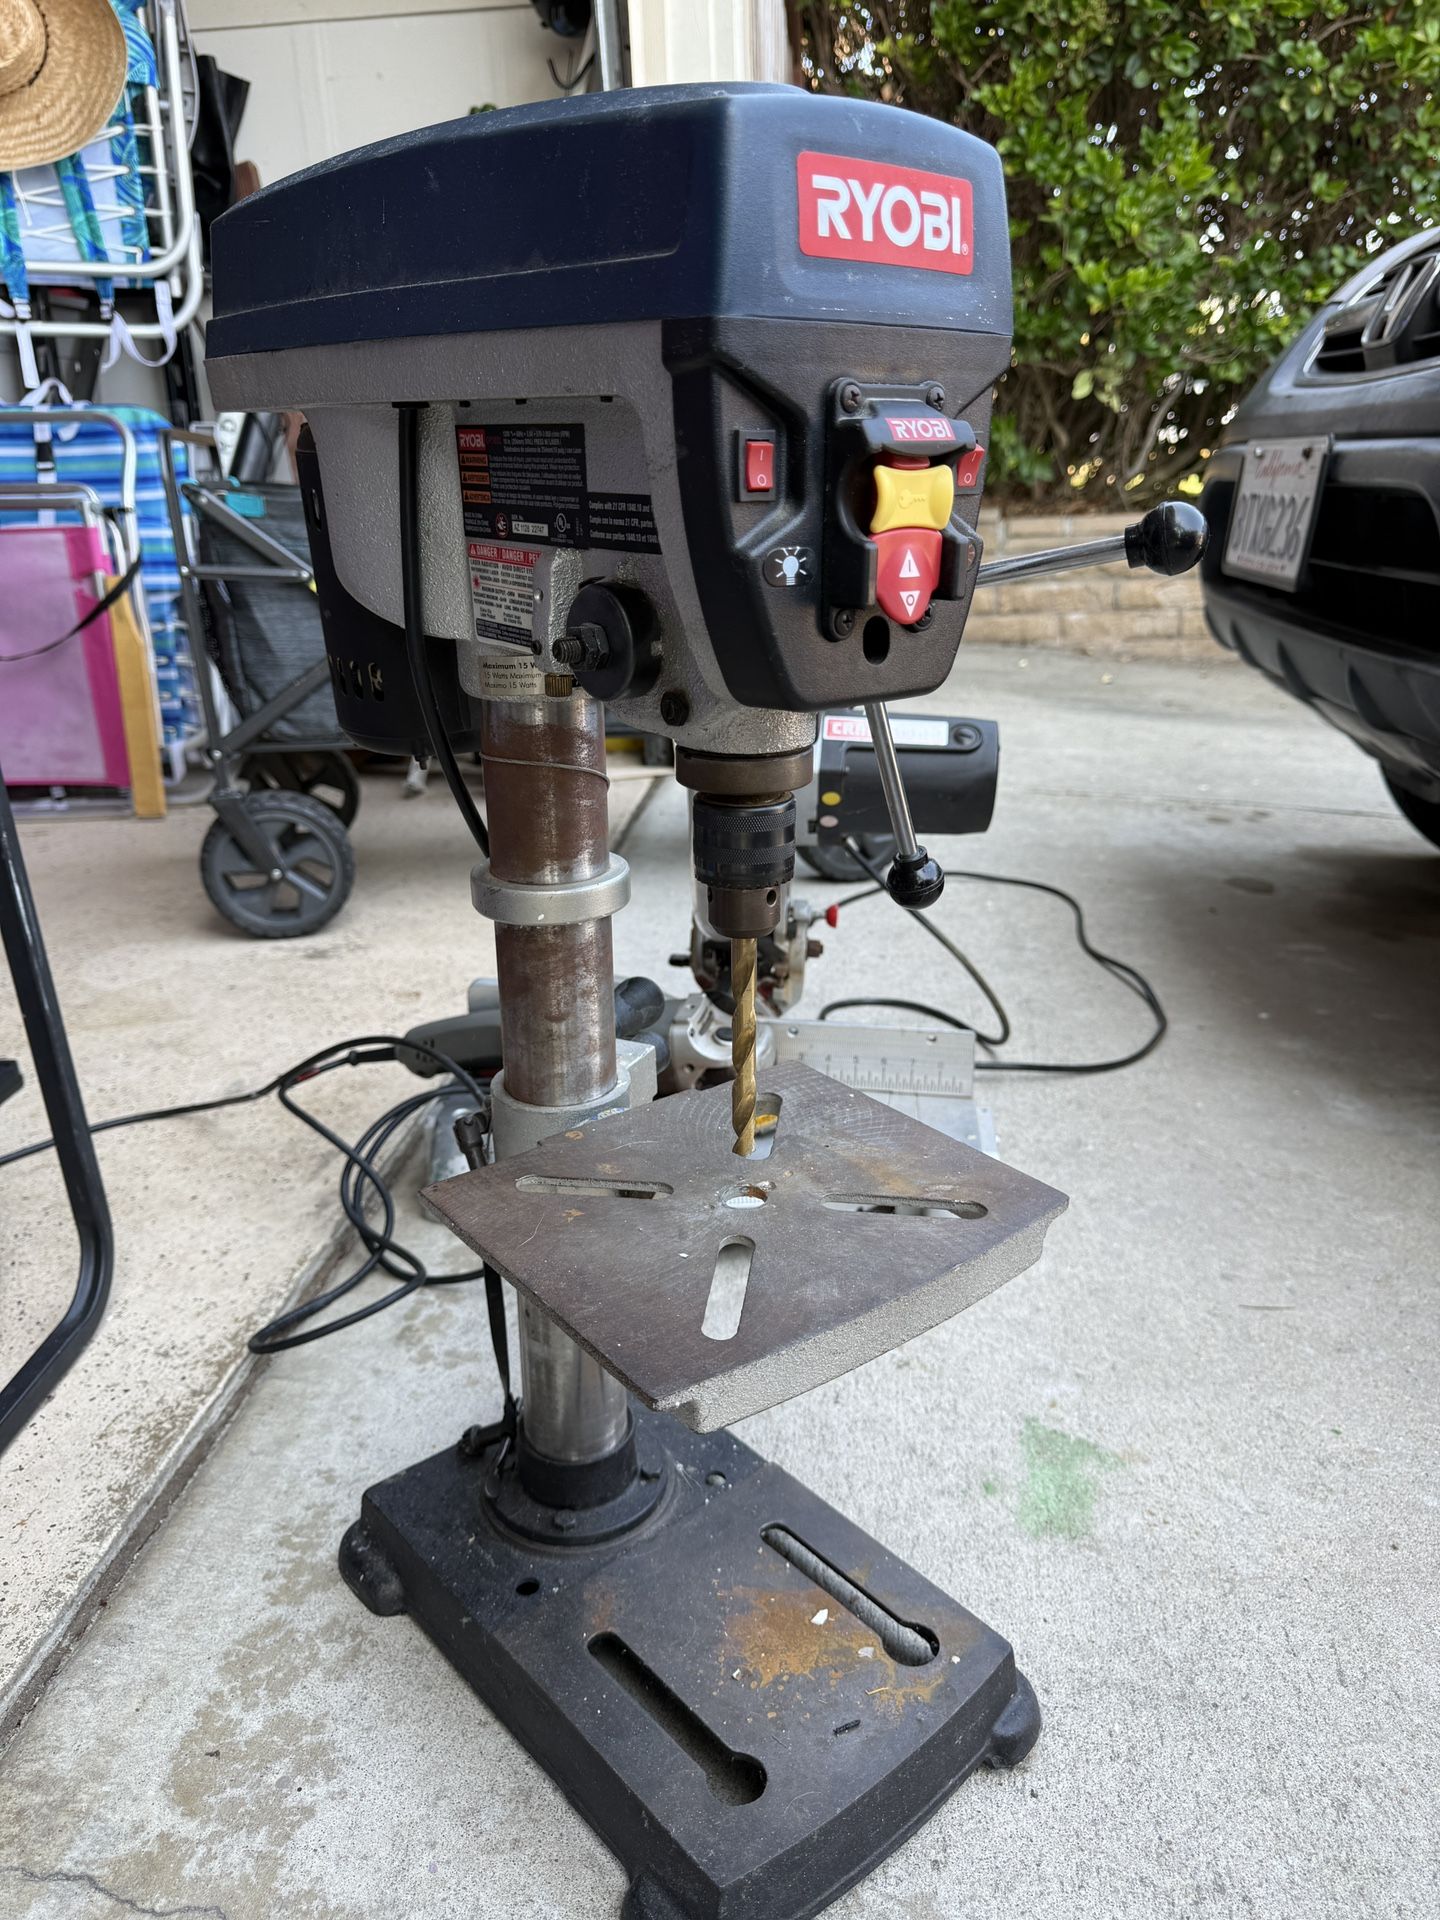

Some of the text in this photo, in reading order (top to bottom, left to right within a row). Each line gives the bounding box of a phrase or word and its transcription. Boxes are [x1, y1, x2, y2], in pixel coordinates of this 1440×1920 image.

[811, 174, 961, 255] RYOBI
[891, 420, 952, 439] RYOBI
[459, 433, 485, 448] RYOBI
[476, 545, 498, 558] DANGER
[502, 549, 524, 562] DANGER
